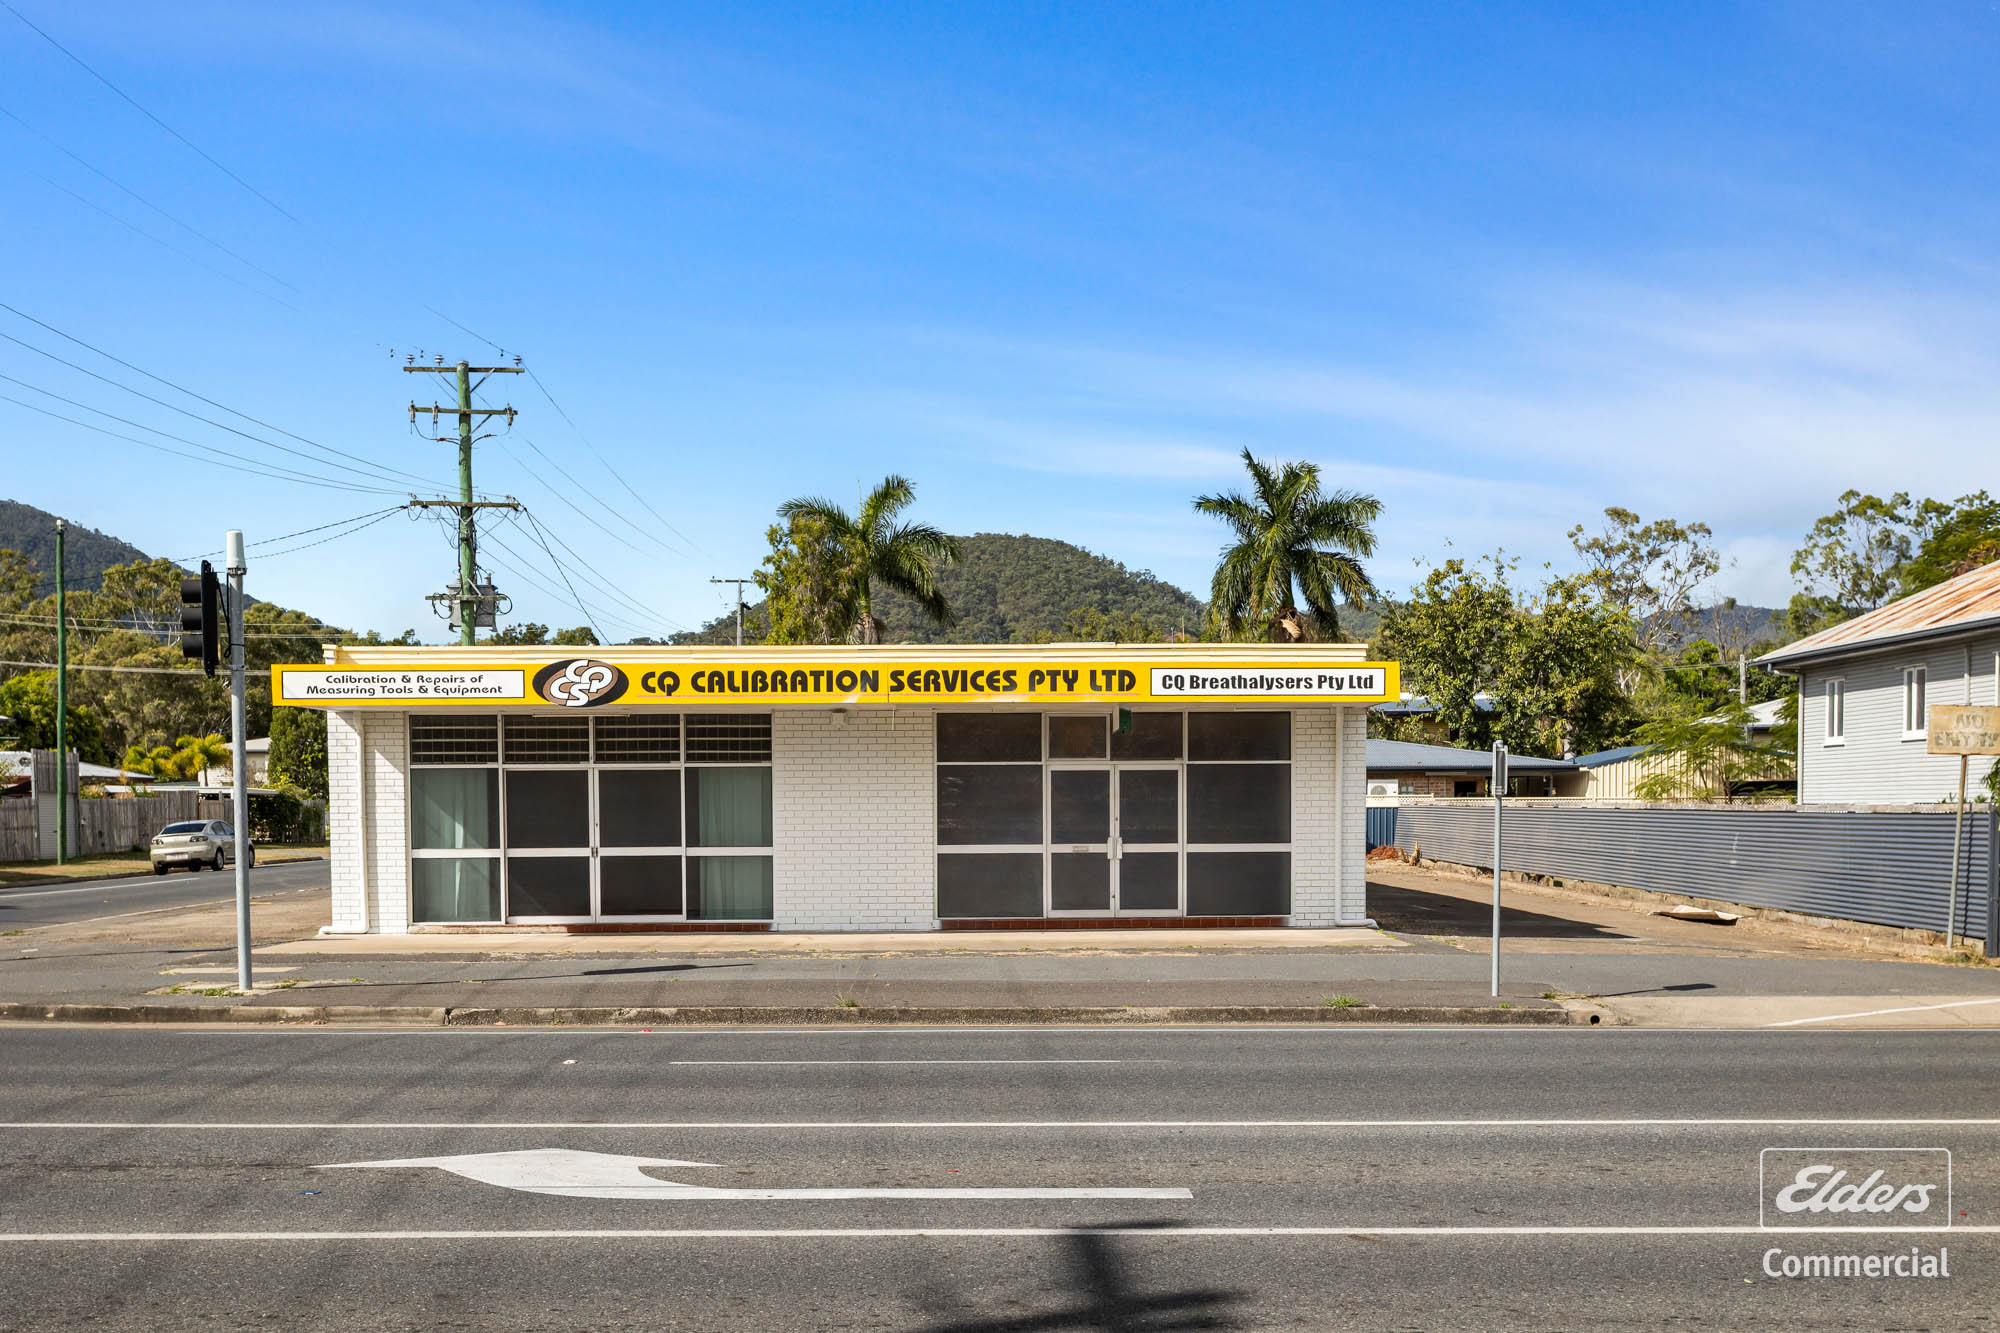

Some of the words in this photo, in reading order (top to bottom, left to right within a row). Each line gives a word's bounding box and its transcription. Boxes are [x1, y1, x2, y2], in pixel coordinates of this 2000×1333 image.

[325, 675, 396, 684] Calibration
[401, 675, 411, 684] &
[416, 675, 465, 686] Repairs
[470, 674, 484, 684] of
[640, 671, 681, 697] CQ
[690, 669, 880, 694] CALIBRATION
[889, 669, 1018, 692] SERVICES
[1028, 669, 1079, 692] PTY
[1089, 669, 1137, 692] LTD
[1161, 674, 1185, 691] CQ
[1189, 674, 1314, 691] Breathalysers
[1317, 674, 1345, 691] Pty
[1348, 674, 1374, 689] Ltd
[306, 685, 376, 697] Measuring
[379, 685, 413, 694] Tools
[418, 685, 429, 694] &
[433, 684, 503, 696] Equipment
